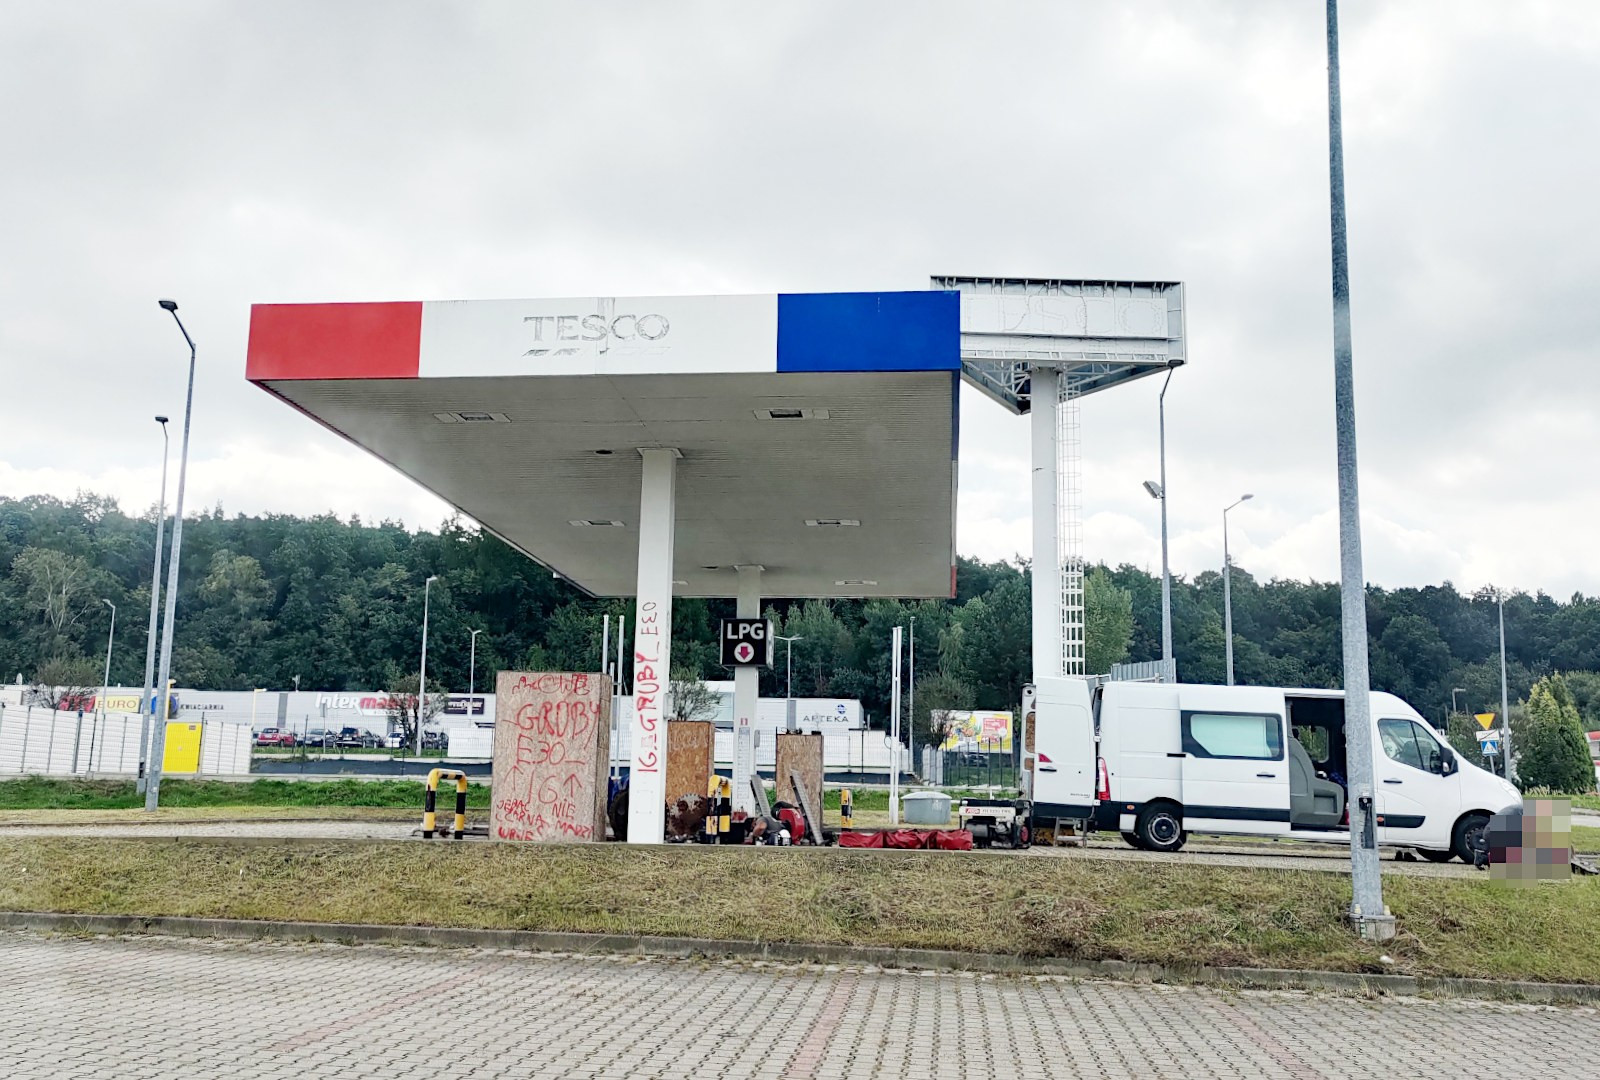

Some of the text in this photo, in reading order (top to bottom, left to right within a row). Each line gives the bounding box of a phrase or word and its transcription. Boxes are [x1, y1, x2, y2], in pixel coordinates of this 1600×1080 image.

[523, 314, 670, 341] TESCO
[727, 623, 765, 640] LPG
[98, 700, 137, 709] EURO
